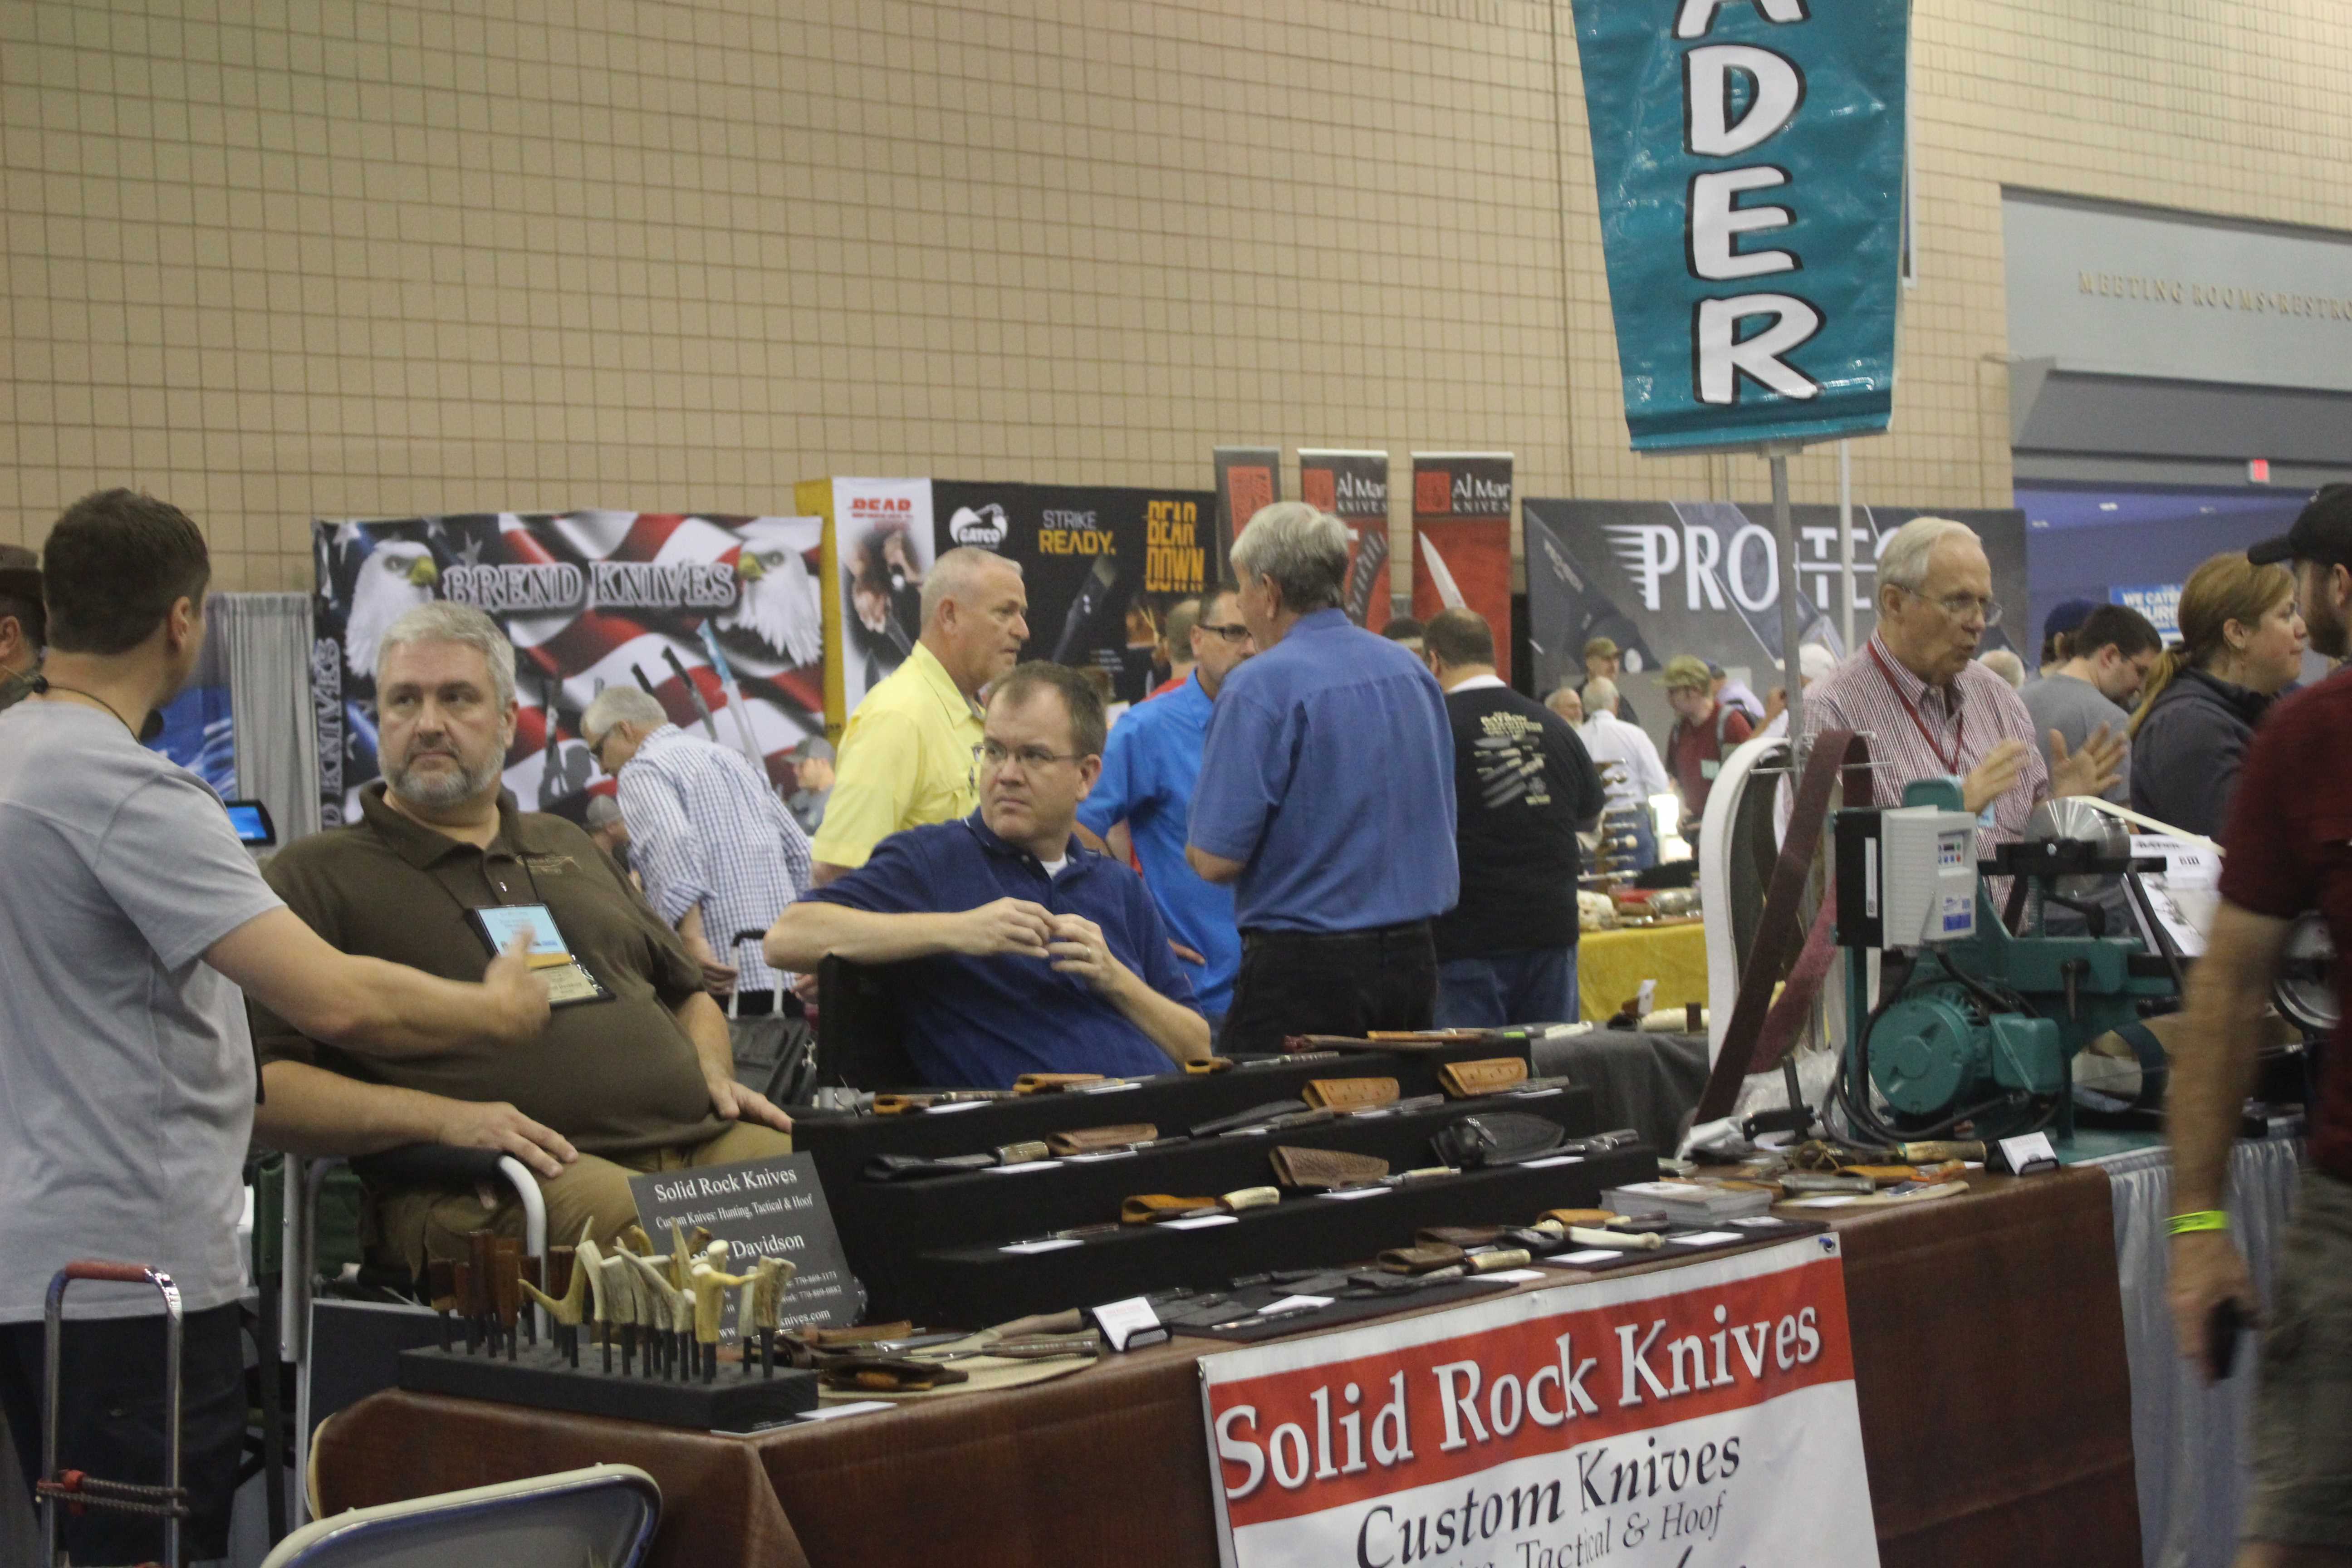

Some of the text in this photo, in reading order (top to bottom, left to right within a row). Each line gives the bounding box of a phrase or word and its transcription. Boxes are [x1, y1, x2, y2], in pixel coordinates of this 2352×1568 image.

[2078, 271, 2183, 304] MEETING
[2192, 284, 2265, 313] ROOMS
[1337, 470, 1353, 498] Al
[1452, 473, 1510, 499] Al Mar
[1043, 510, 1097, 529] STRIKE
[1453, 501, 1509, 513] KNIVES
[1038, 529, 1117, 556] READY.
[443, 561, 737, 612] BREND KNIVES
[312, 637, 342, 796] KNIVES
[654, 1168, 797, 1202] Solid Rock Knives
[656, 1215, 688, 1230] Cusm
[751, 1198, 783, 1215] Tactical
[784, 1197, 792, 1211] &
[792, 1193, 813, 1210] Hoof
[730, 1234, 805, 1259] Davidson
[1215, 1304, 1821, 1500] Solid Rock Knives
[1357, 1435, 1741, 1568] Custom Knives
[1516, 1490, 1726, 1568] Tactical & Hoof
